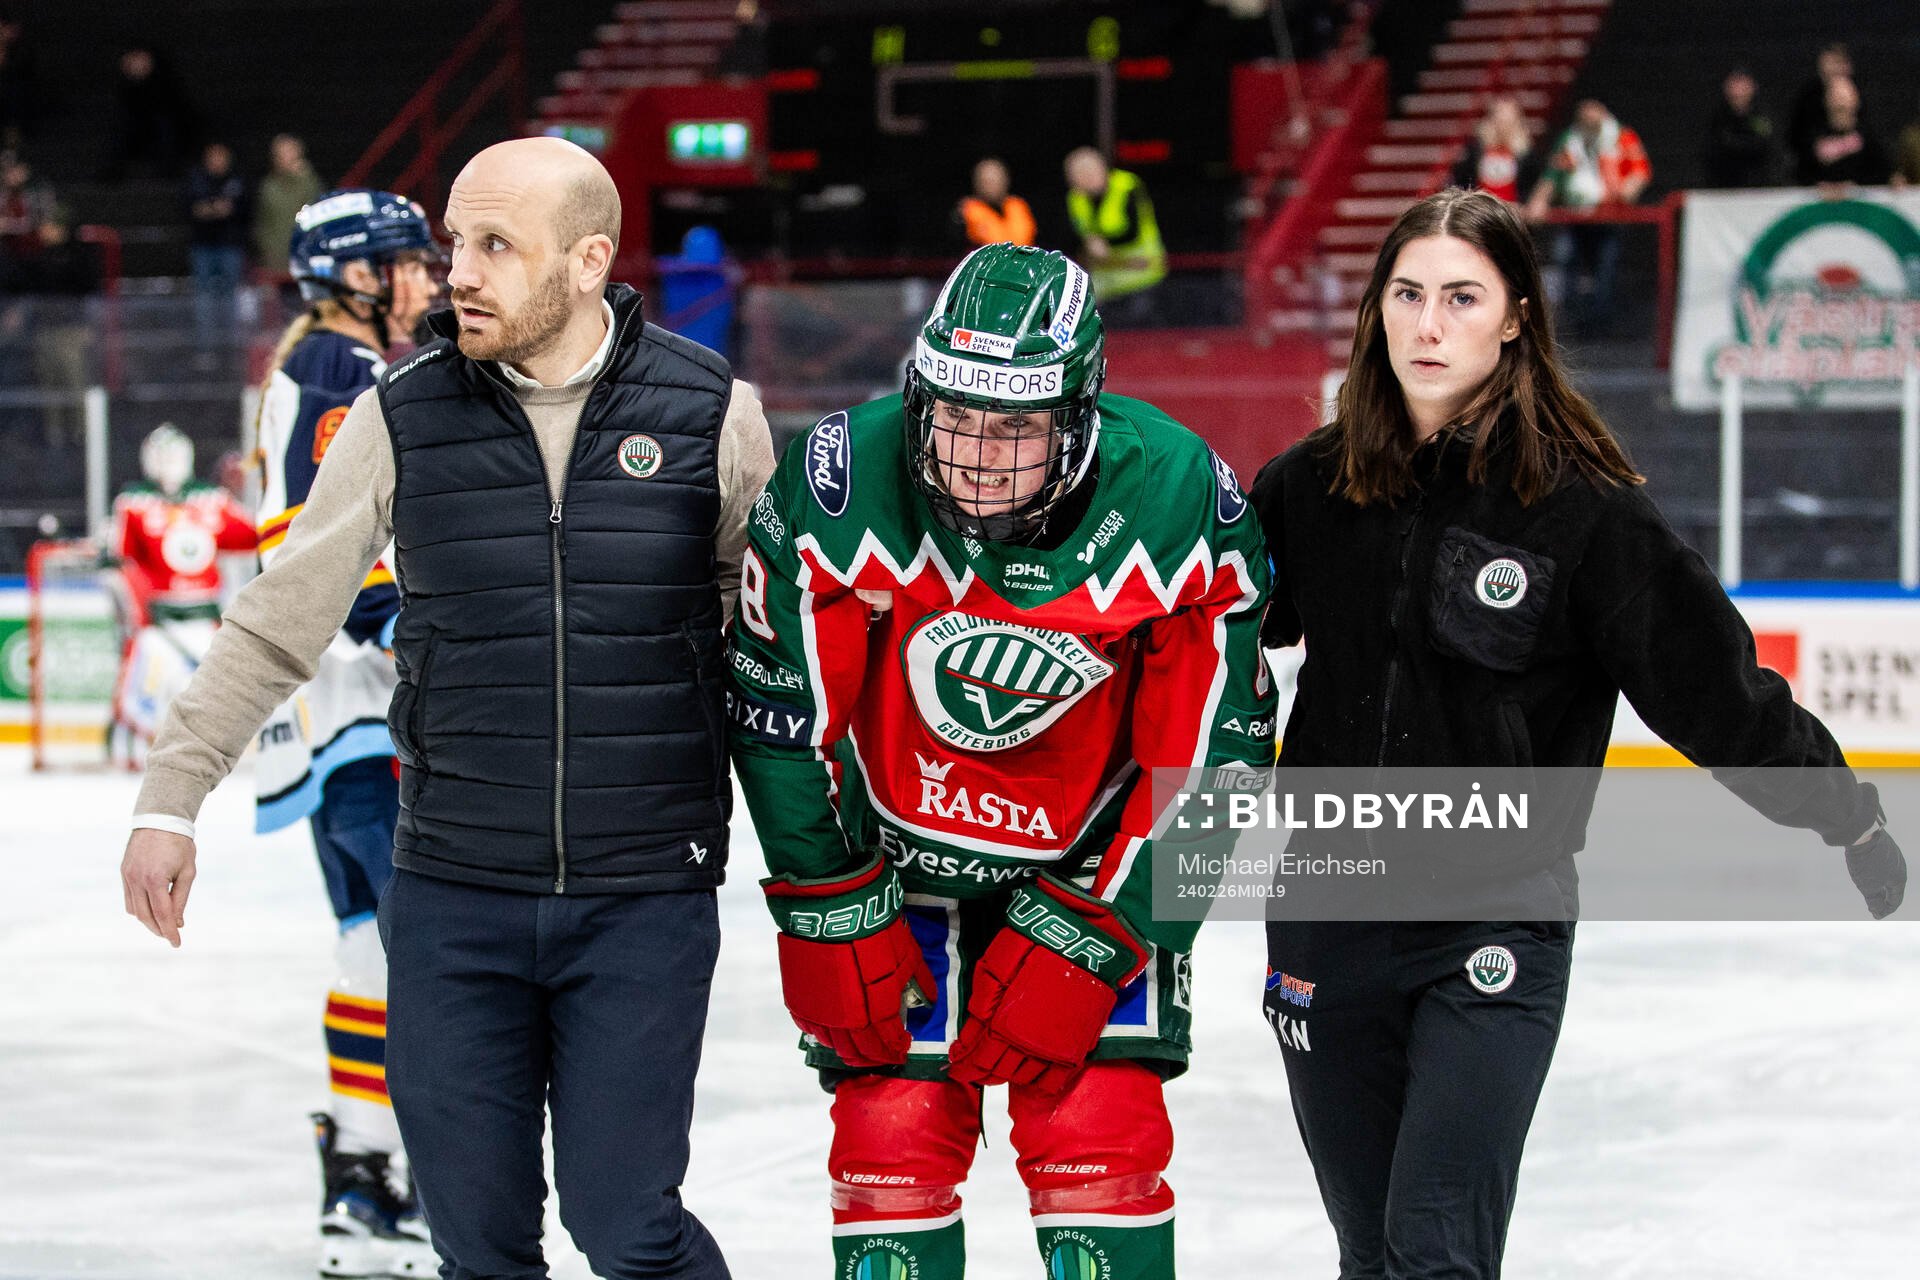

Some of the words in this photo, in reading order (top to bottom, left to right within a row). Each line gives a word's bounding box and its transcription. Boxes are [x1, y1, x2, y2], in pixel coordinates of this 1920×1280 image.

[971, 343, 992, 353] SPEL
[973, 336, 1012, 350] SVENSKA
[936, 359, 1057, 395] BJURFORS
[813, 424, 844, 490] Ford
[1091, 509, 1120, 543] INTER
[1098, 514, 1126, 549] SPORT
[1005, 563, 1047, 580] SDHL
[1820, 646, 1920, 678] SVEN
[936, 721, 1031, 750] GÖTEBORG
[916, 778, 1058, 840] RASTA
[1280, 986, 1313, 1008] SPORT
[1281, 972, 1313, 996] INTER
[1265, 1006, 1312, 1052] TKN
[850, 1173, 916, 1185] BAUER
[1042, 1163, 1107, 1175] BAUER
[1053, 1230, 1096, 1249] JÖRGEN
[846, 1250, 860, 1280] ANKT
[862, 1238, 909, 1256] JÖRGEN
